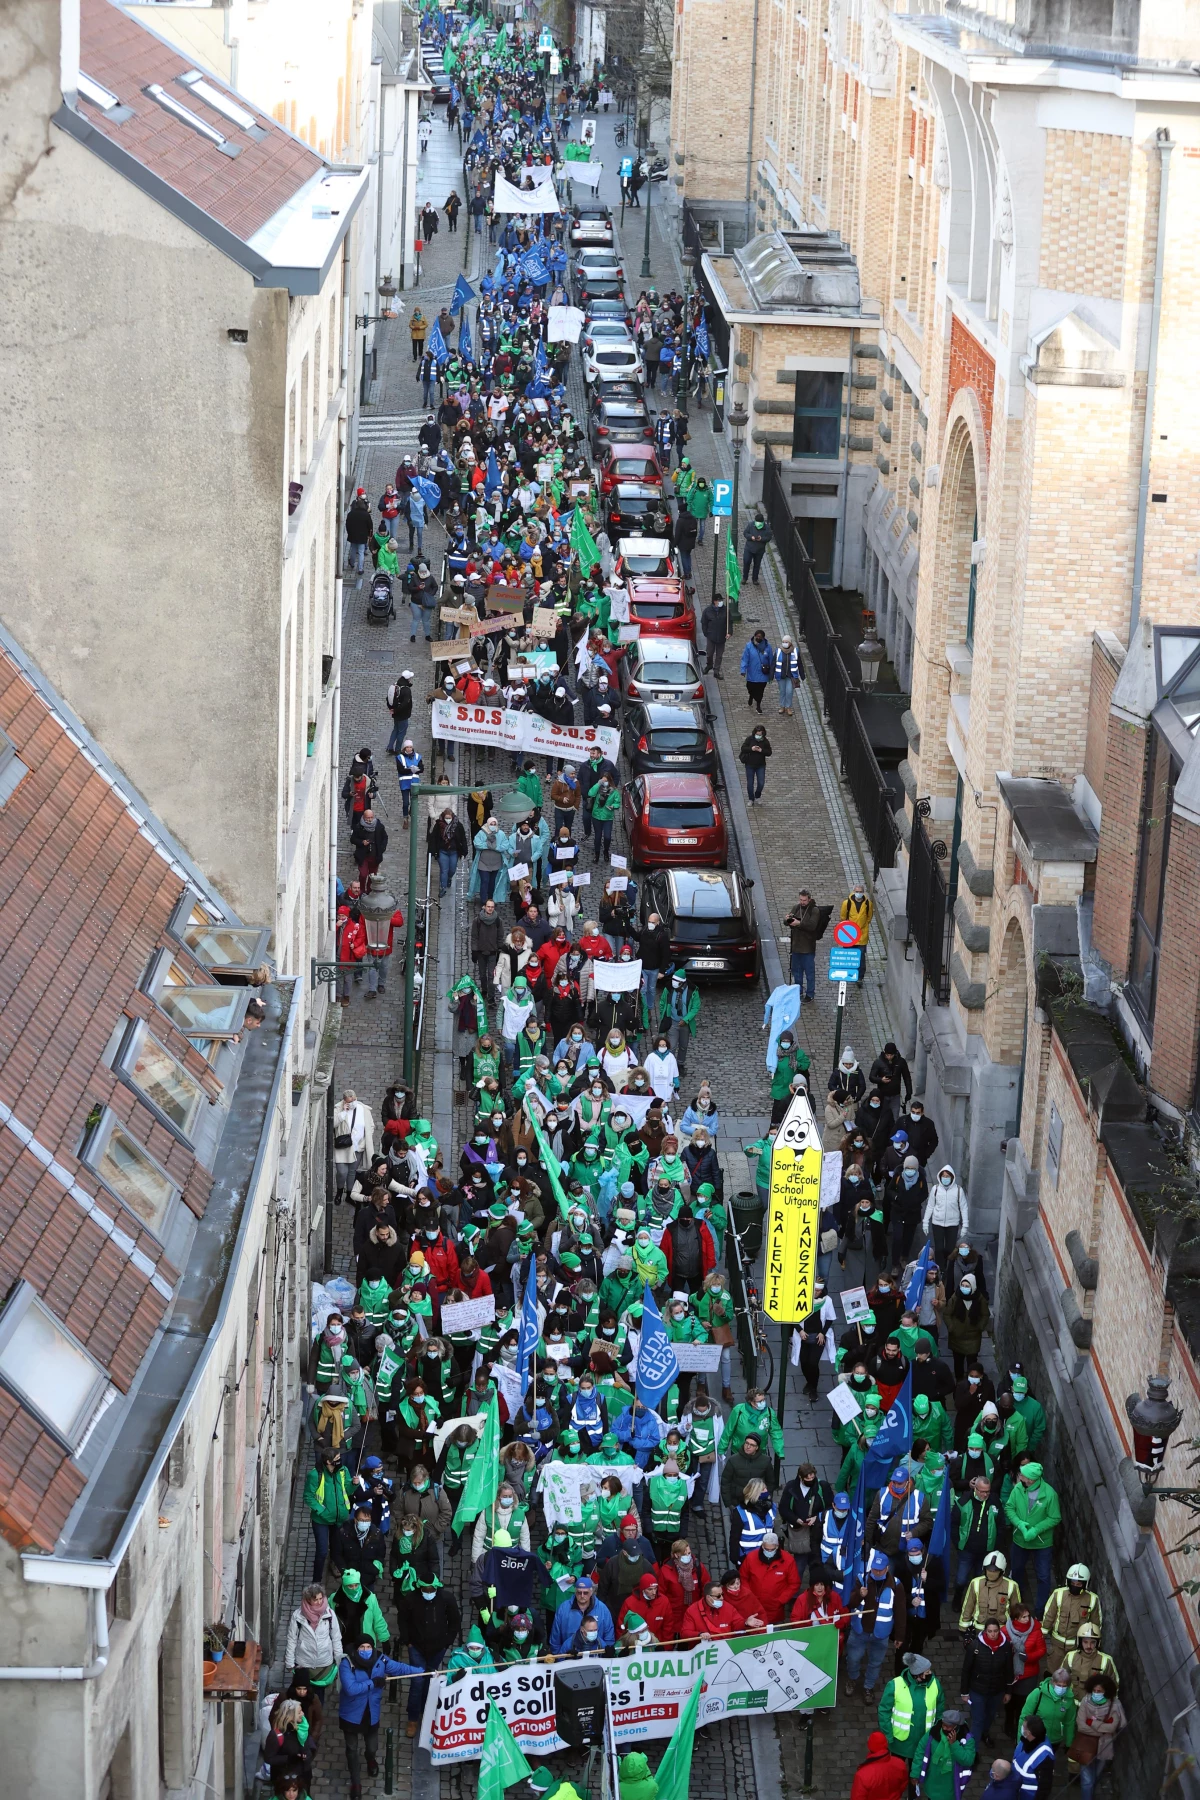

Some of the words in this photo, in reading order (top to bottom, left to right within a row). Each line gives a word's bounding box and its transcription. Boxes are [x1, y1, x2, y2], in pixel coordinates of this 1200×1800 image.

[622, 159, 632, 170] P
[716, 483, 730, 502] P
[457, 706, 502, 725] S.O.S
[551, 724, 596, 742] S.O.S
[546, 738, 575, 748] soignants
[774, 1160, 805, 1172] Sortie
[772, 1183, 804, 1194] School
[784, 1195, 818, 1210] Uitgang
[769, 1211, 784, 1311] RALENTIR
[795, 1212, 812, 1312] LANGZAAM
[470, 1680, 512, 1701] des
[517, 1669, 552, 1692] soi
[627, 1644, 719, 1681] QUALITÉ
[443, 1733, 466, 1747] AUX
